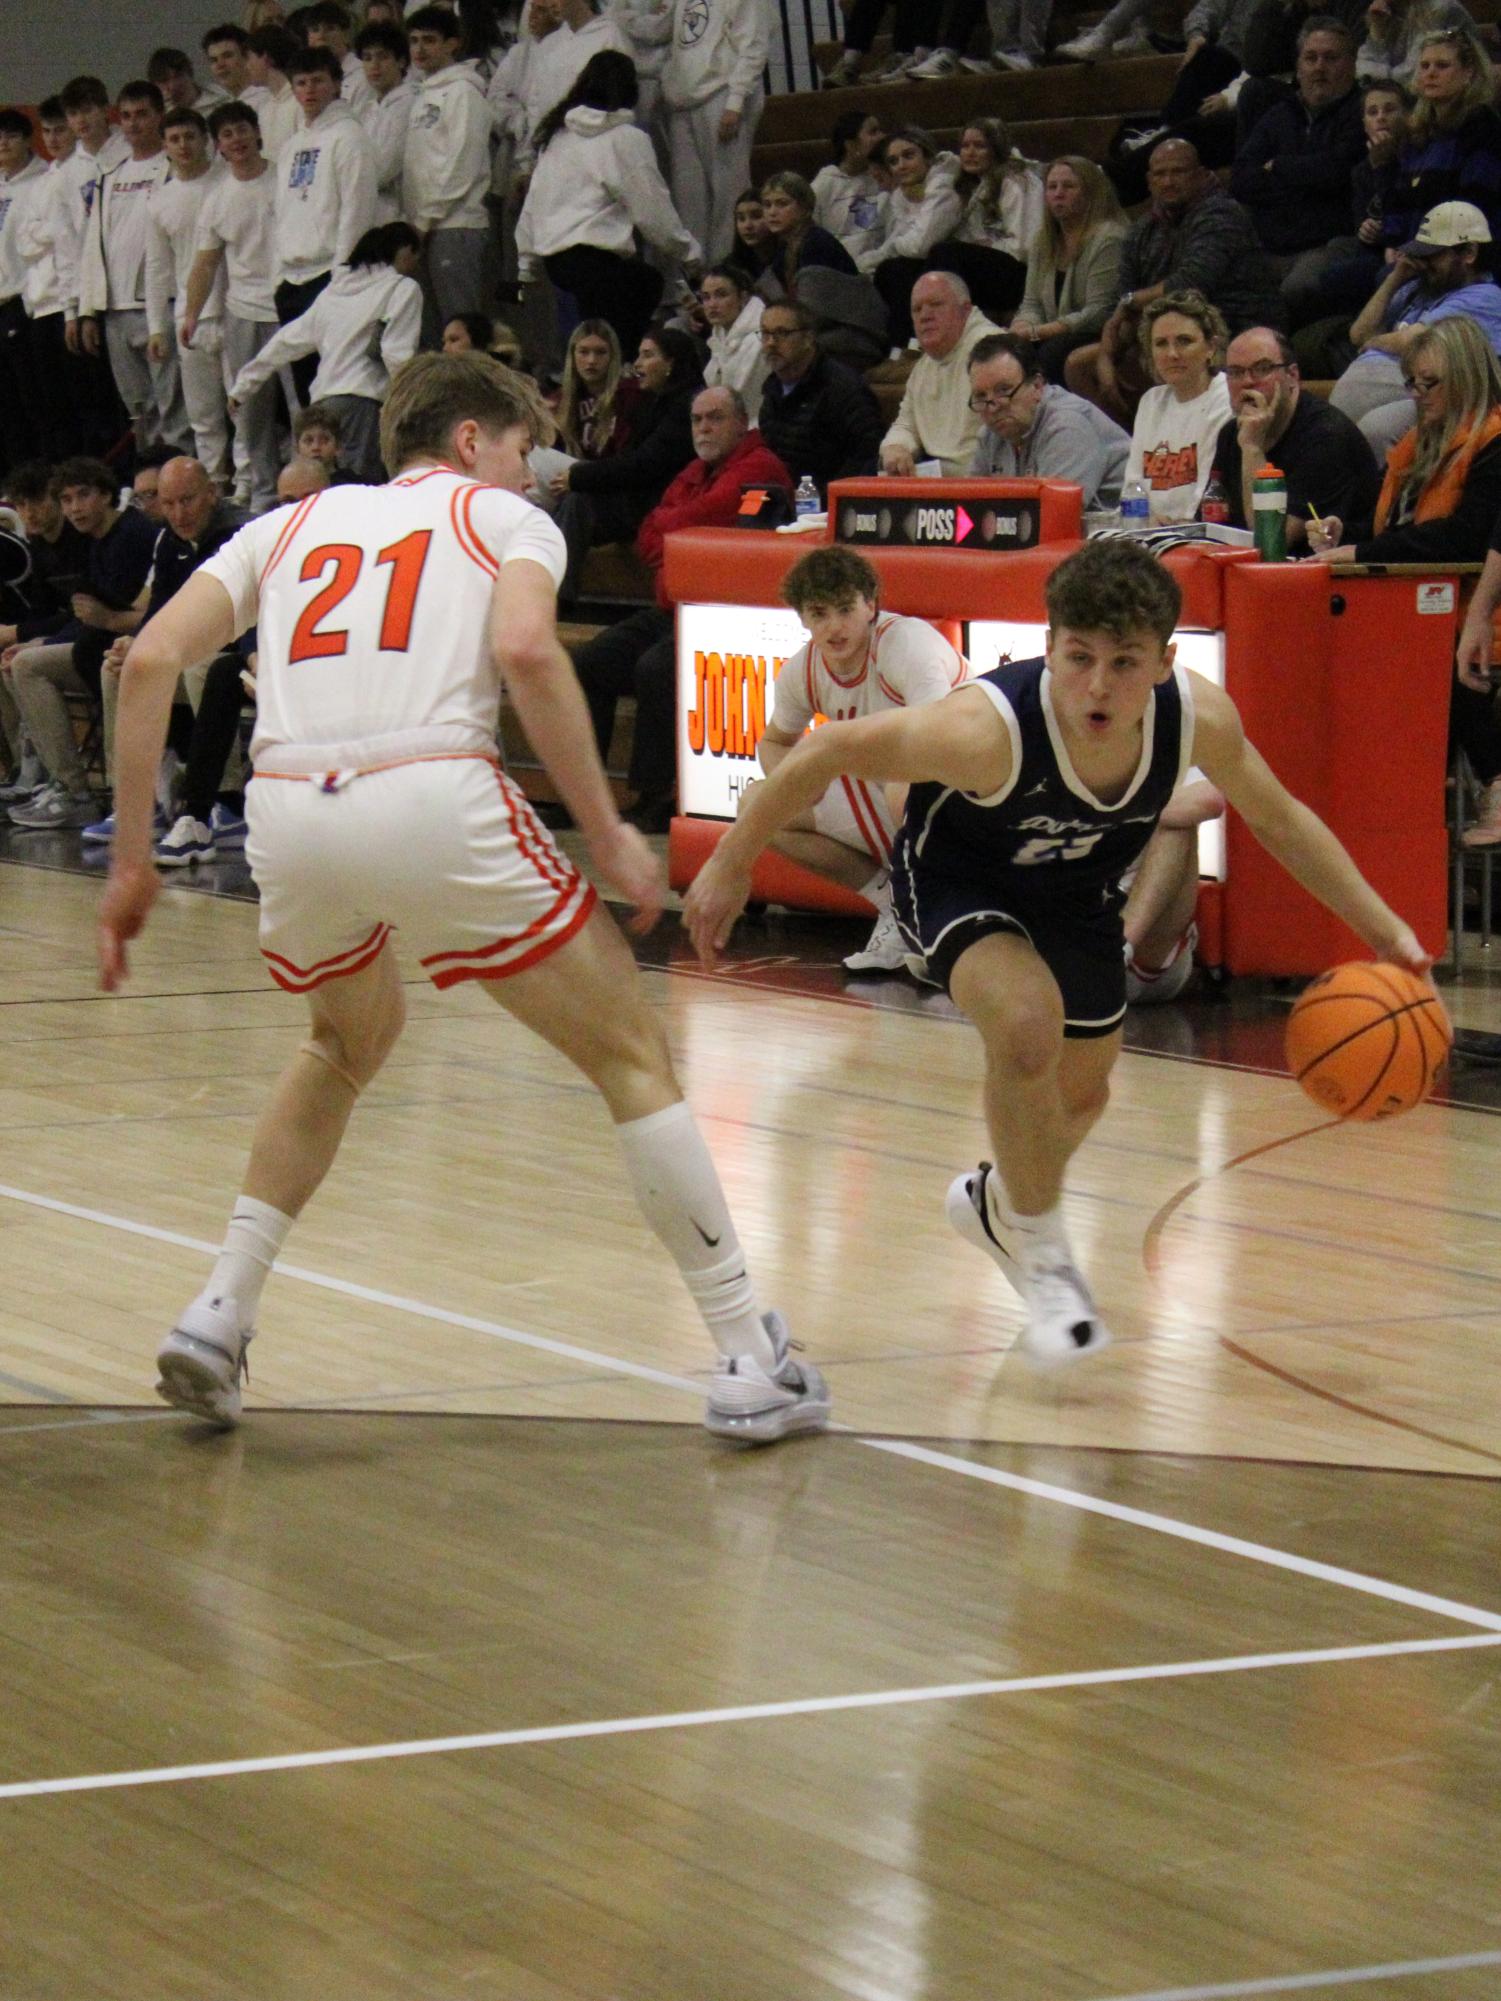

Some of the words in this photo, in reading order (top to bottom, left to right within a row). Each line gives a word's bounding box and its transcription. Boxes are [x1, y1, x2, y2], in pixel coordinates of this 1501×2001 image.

[916, 508, 955, 541] POSS
[288, 528, 434, 665] 21
[687, 650, 767, 761] JOHN
